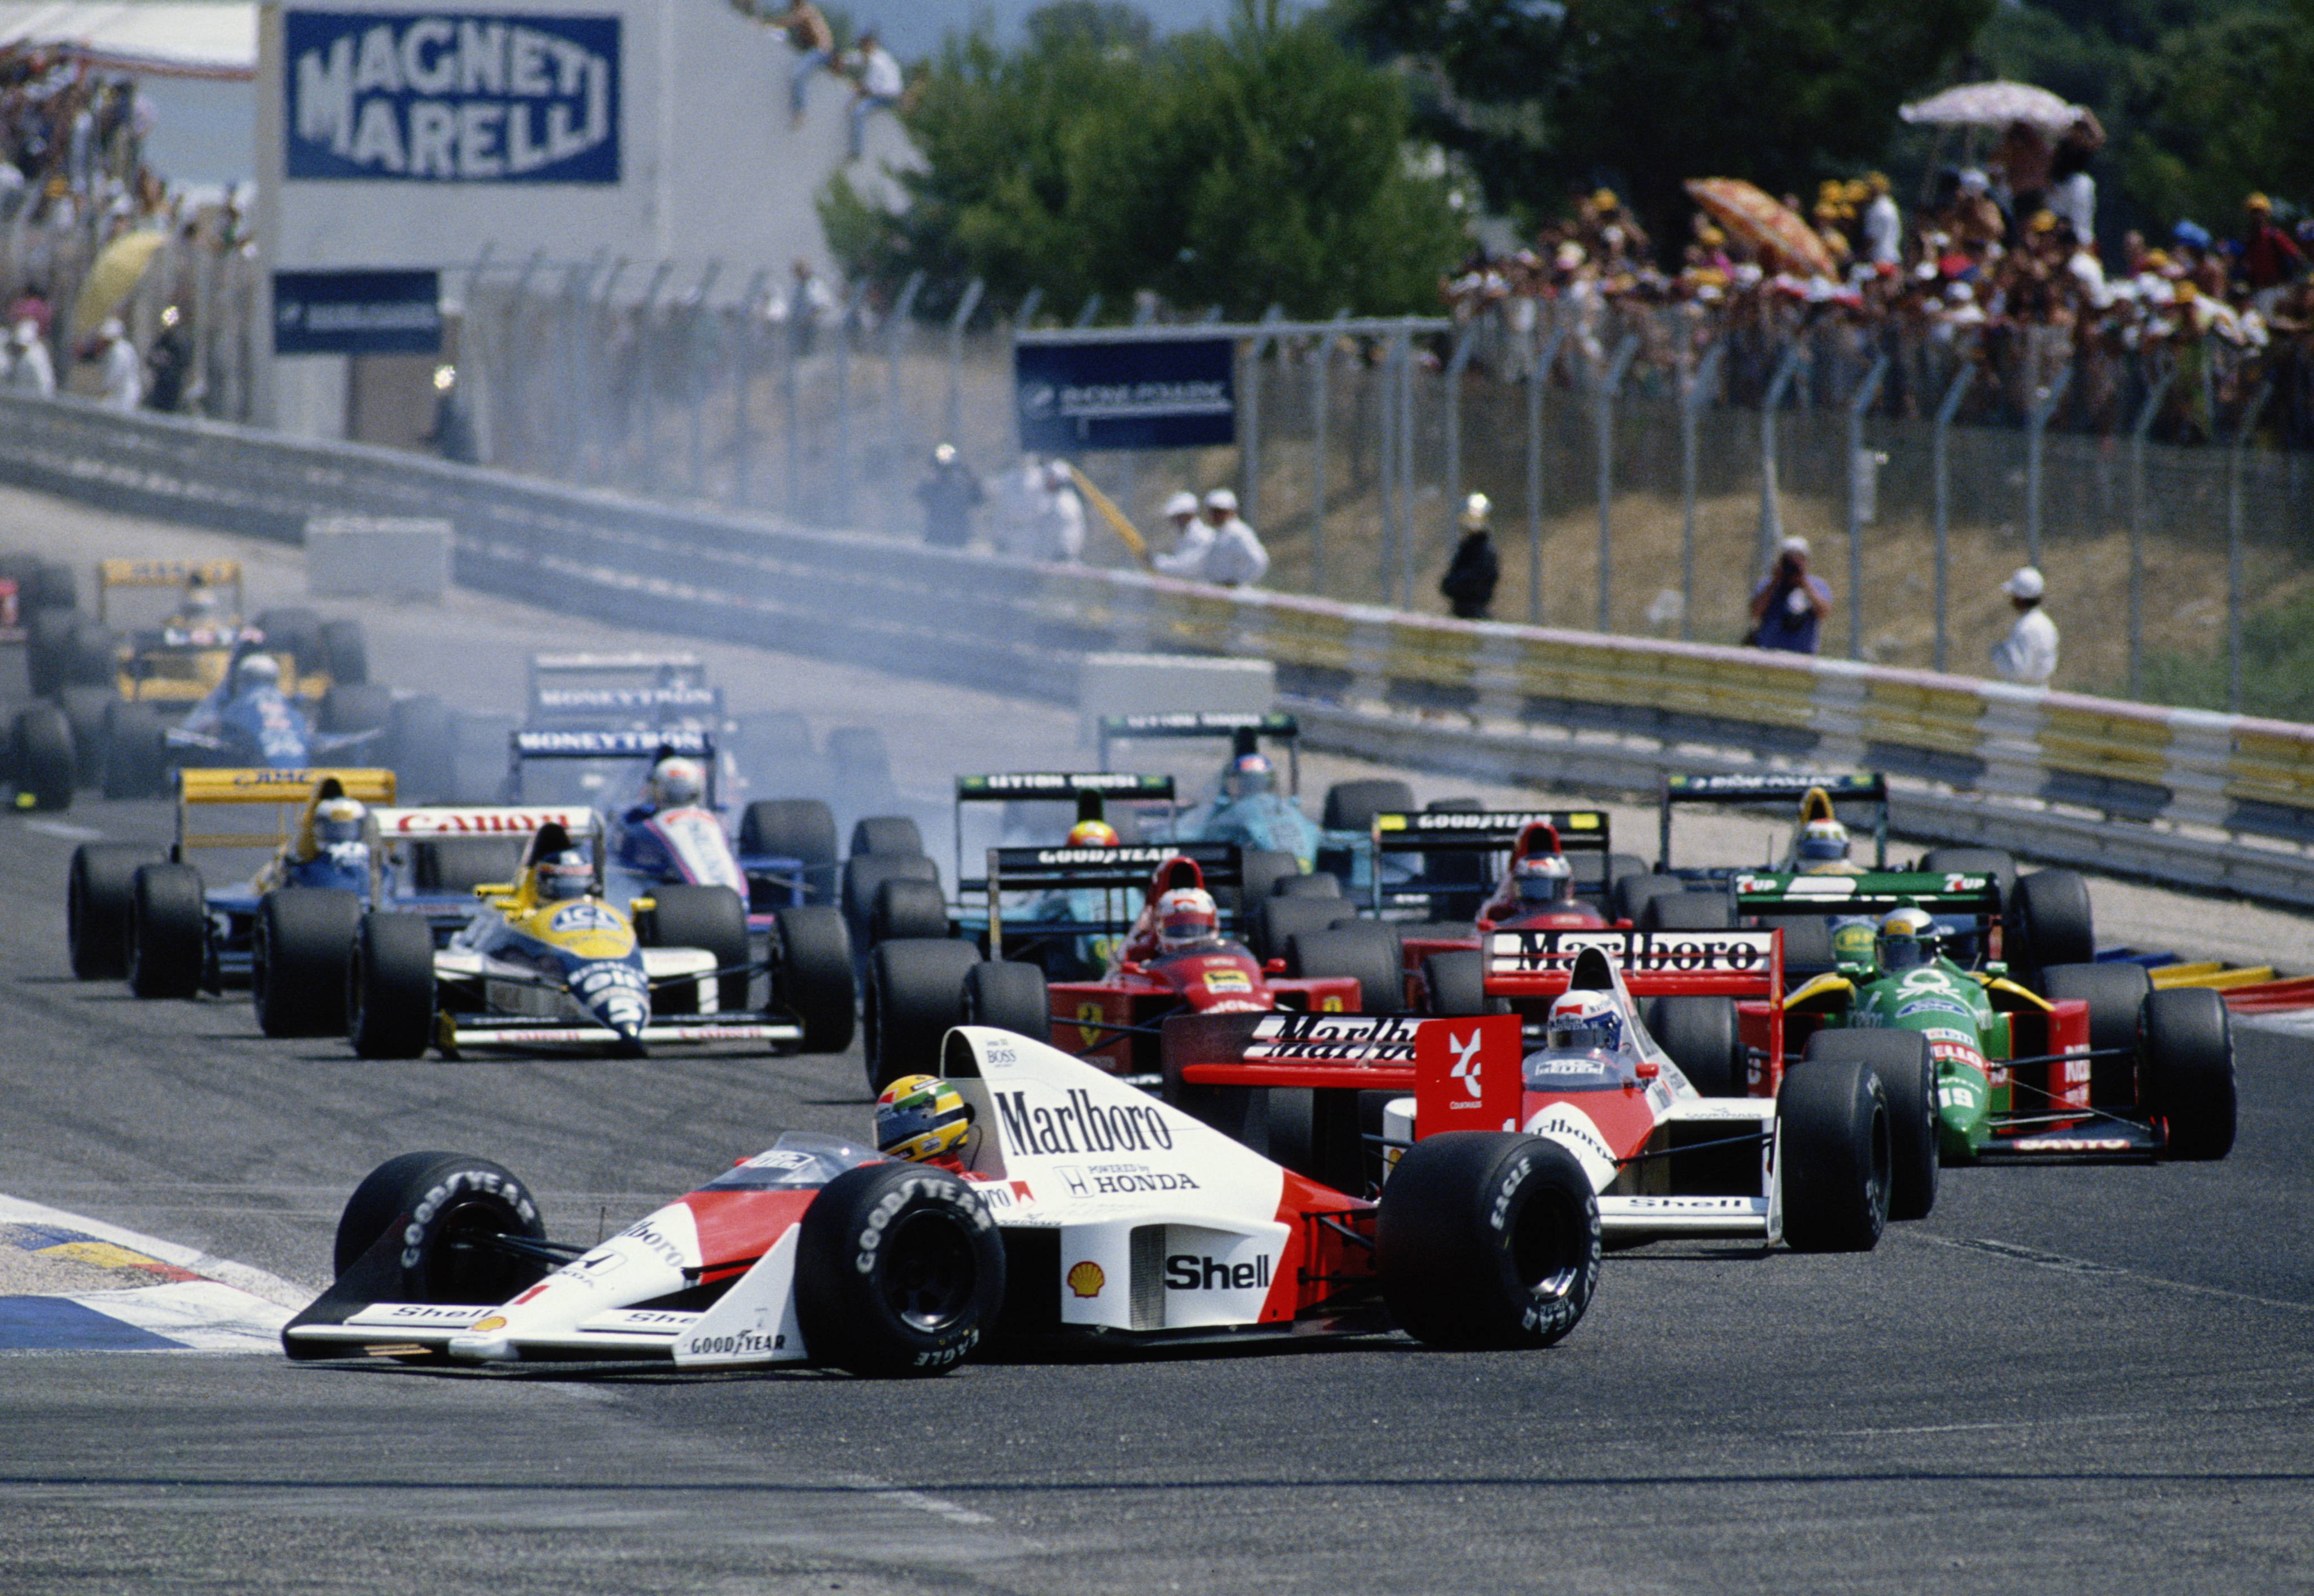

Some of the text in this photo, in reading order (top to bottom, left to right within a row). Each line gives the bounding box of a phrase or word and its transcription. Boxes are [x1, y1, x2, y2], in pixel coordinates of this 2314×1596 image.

[297, 19, 608, 127] MAGNETI
[297, 61, 608, 176] MARELLI
[518, 733, 705, 749] MONEYTRON
[1418, 814, 1552, 830] GOODYEAR
[1038, 848, 1180, 863] GOODYEAR
[1517, 932, 1758, 971] Marlboro
[986, 1050, 1017, 1064] BOSS
[1938, 1087, 1974, 1109] 19
[993, 1089, 1173, 1156] Marlboro
[1088, 1163, 1150, 1175] POWERED by
[1094, 1174, 1200, 1193] HONDA
[1629, 1198, 1742, 1208] Shell
[401, 1170, 536, 1269] GOODYEAR
[855, 1178, 992, 1275] GOODYEAR
[1165, 1254, 1270, 1291] Shell
[392, 1306, 496, 1319] Shell
[624, 1312, 698, 1325] She
[691, 1328, 786, 1356] GOODYEAR
